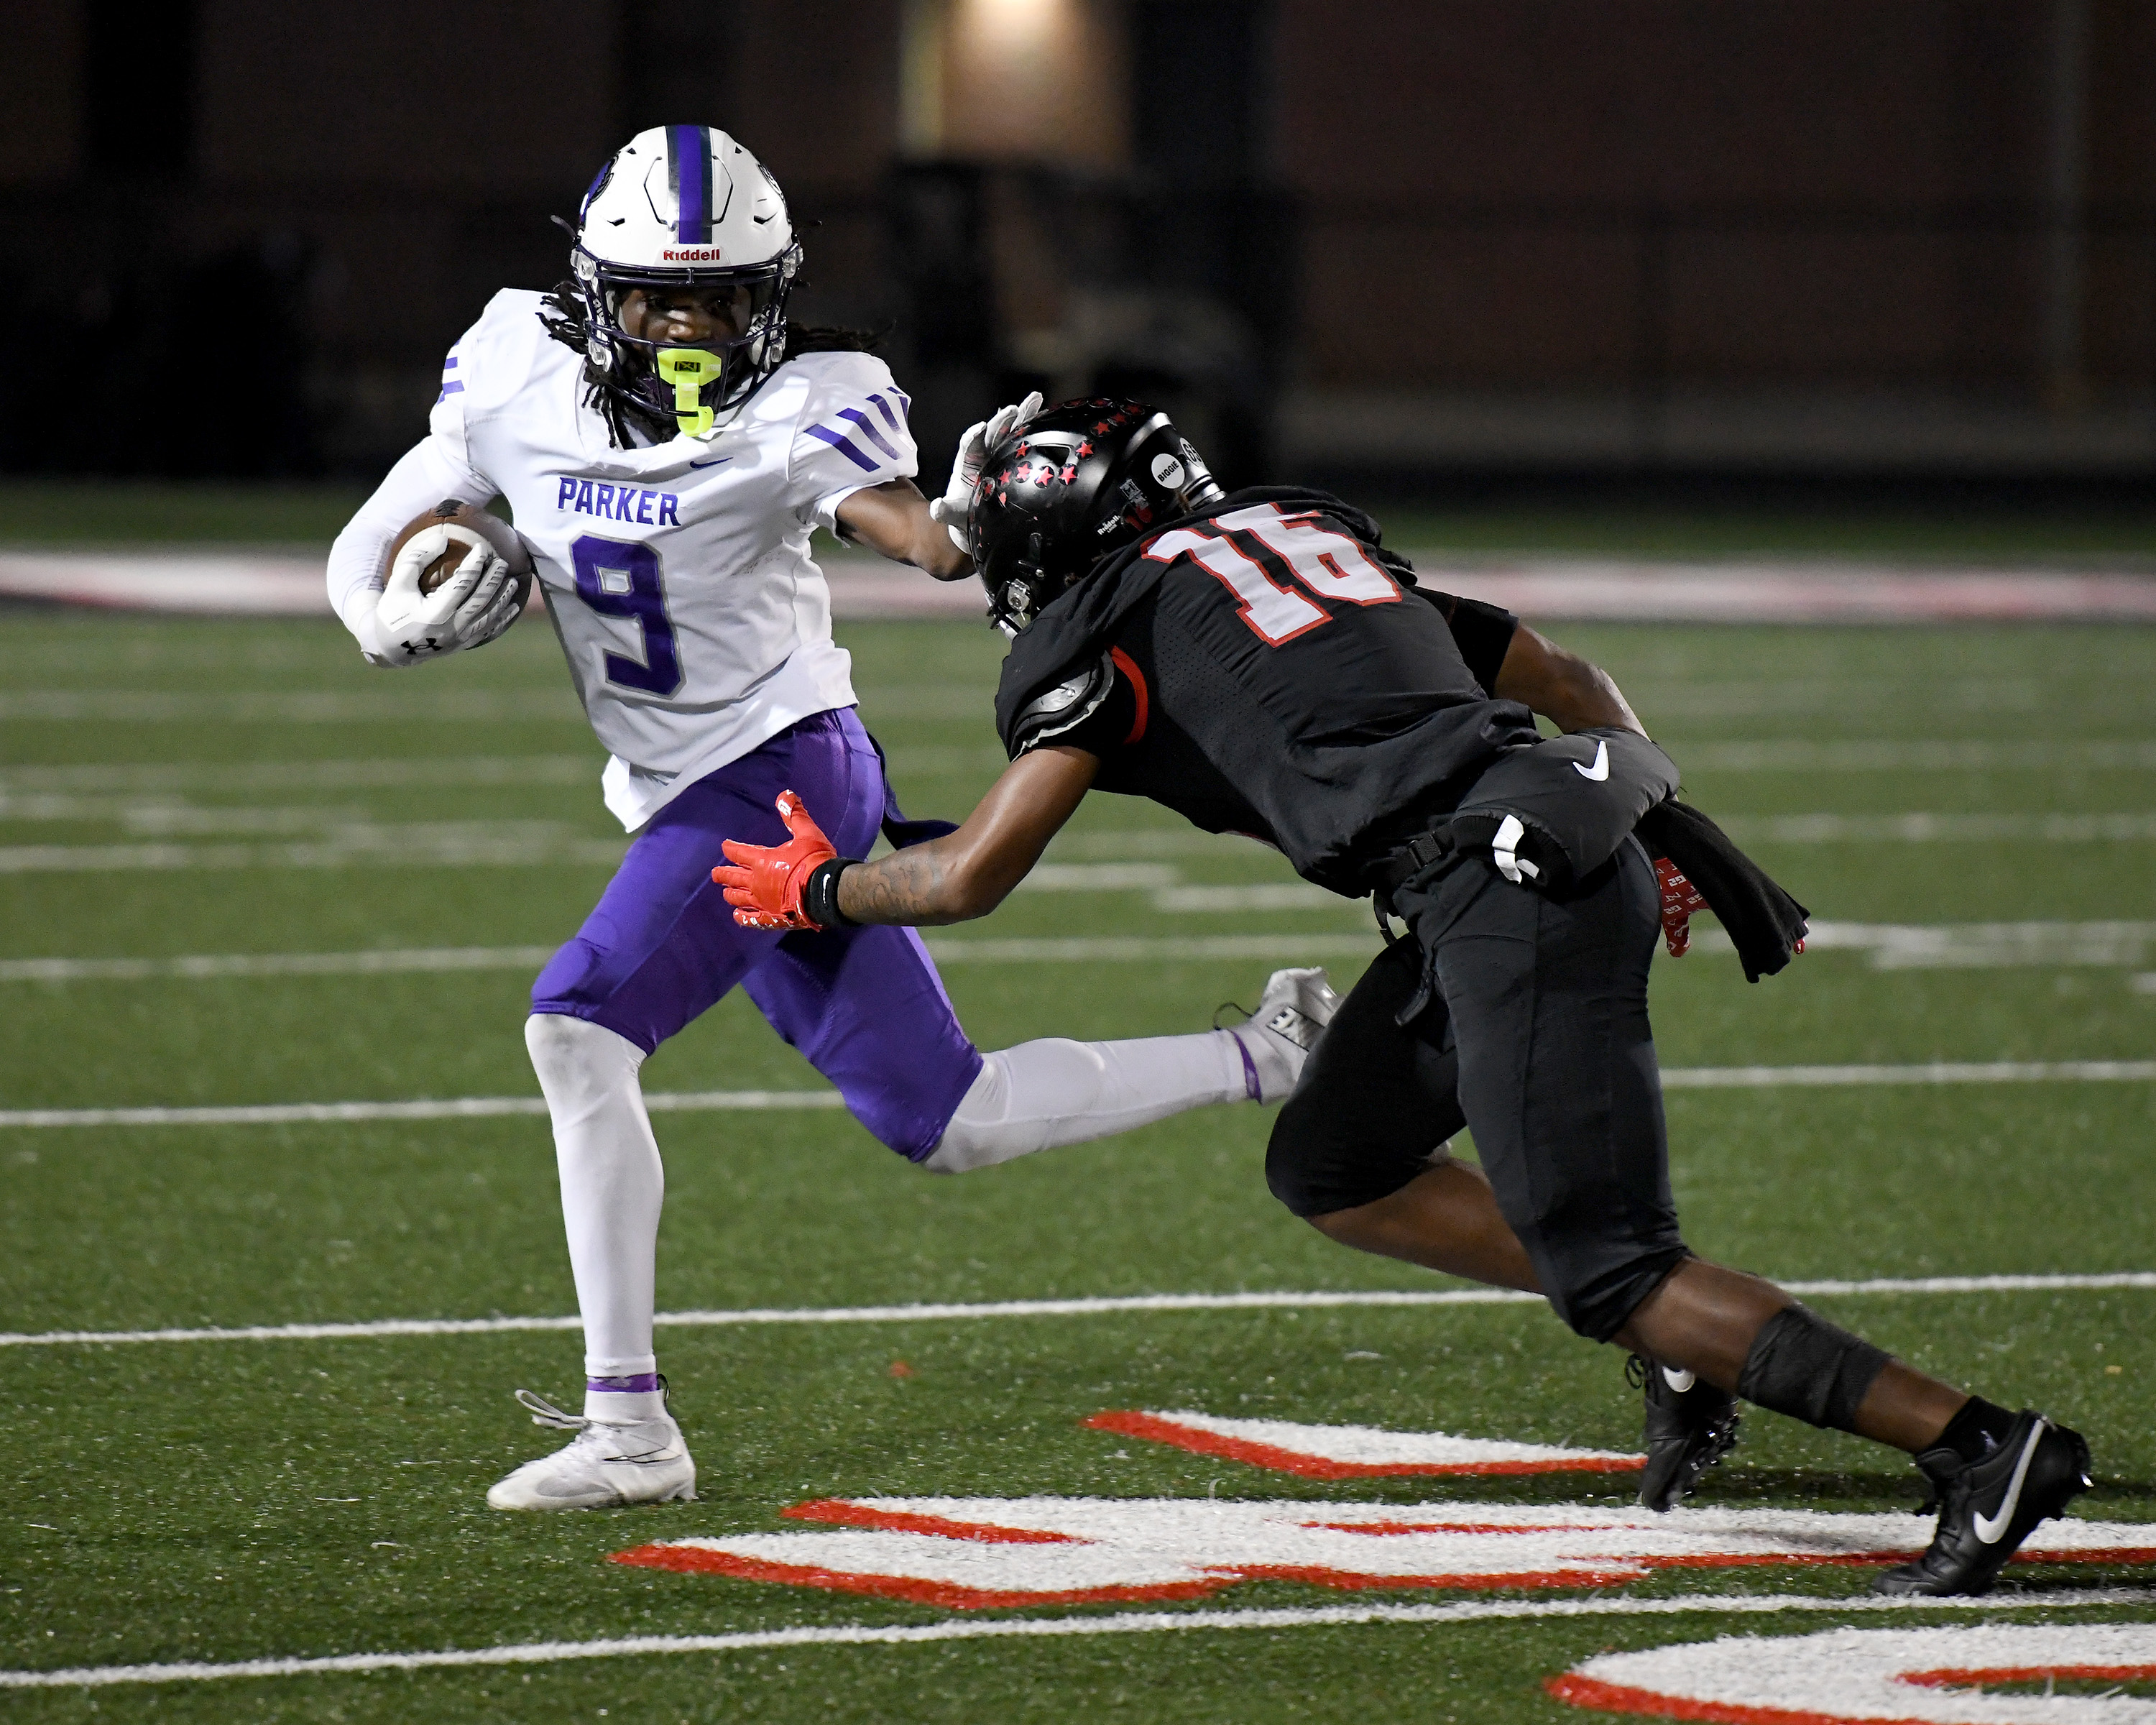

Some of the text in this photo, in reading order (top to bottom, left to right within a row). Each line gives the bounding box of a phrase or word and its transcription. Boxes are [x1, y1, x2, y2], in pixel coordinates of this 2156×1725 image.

[663, 249, 720, 261] Riddell
[1158, 461, 1179, 482] BIGGIE
[558, 477, 681, 526] PARKER
[1140, 502, 1403, 648] 16
[569, 530, 687, 701] 9
